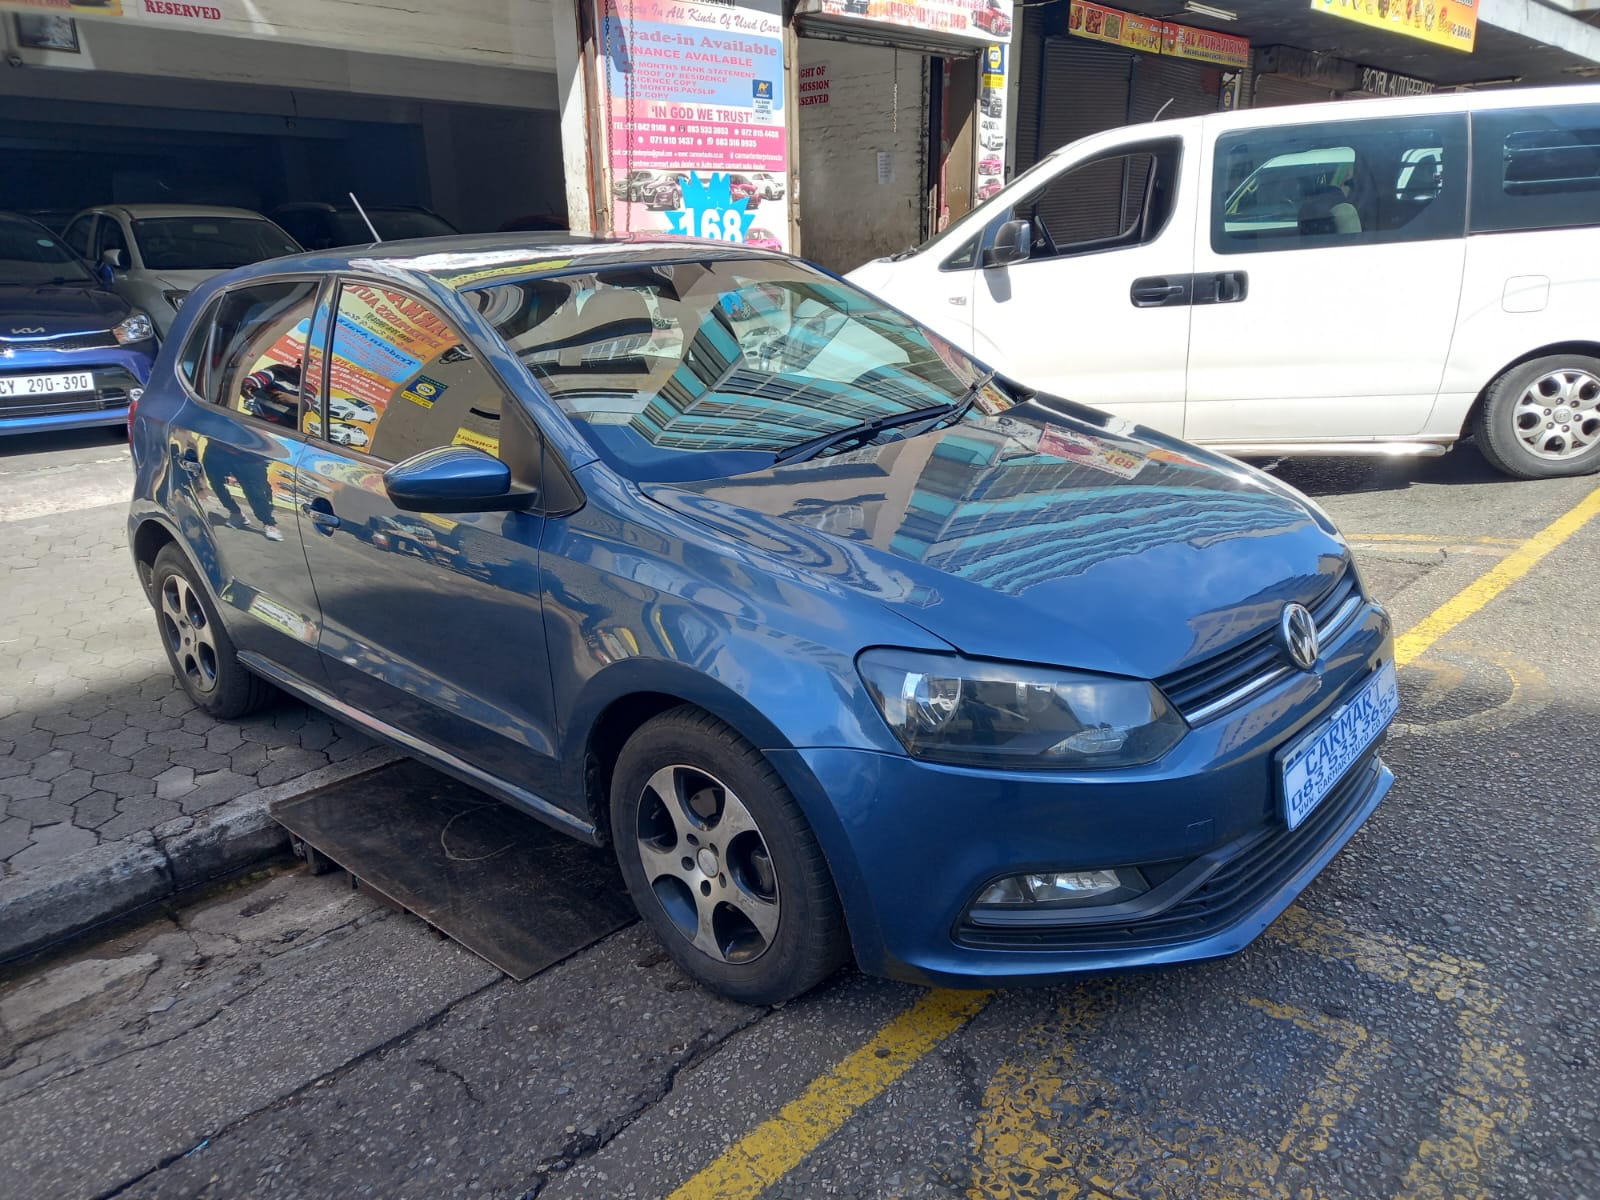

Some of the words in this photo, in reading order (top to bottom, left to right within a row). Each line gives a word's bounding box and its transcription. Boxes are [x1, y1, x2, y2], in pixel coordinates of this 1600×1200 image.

[143, 0, 221, 20] RESERVED
[666, 7, 685, 19] All
[688, 8, 717, 24] Kinds
[719, 13, 732, 29] Of
[734, 15, 757, 31] Used
[760, 19, 781, 33] Cars
[615, 26, 695, 46] Trade-in
[700, 36, 778, 57] Available
[620, 44, 681, 60] FNANCE
[685, 51, 753, 67] AVAILABLE
[638, 61, 678, 70] MONTHS
[681, 65, 705, 73] BANK
[707, 68, 757, 78] STATEMENT
[679, 73, 728, 83] RESIDENCE
[800, 68, 815, 78] GHT
[816, 66, 827, 76] OF
[640, 84, 679, 92] MONTHS
[681, 87, 716, 95] PAYSLIP
[671, 107, 694, 120] GOD
[696, 108, 713, 121] WE
[679, 207, 743, 244] 168
[27, 375, 88, 393] 290-390
[1305, 680, 1380, 776] CARMART
[1292, 765, 1324, 811] 083
[1328, 727, 1358, 770] 533
[1362, 684, 1395, 733] 3653
